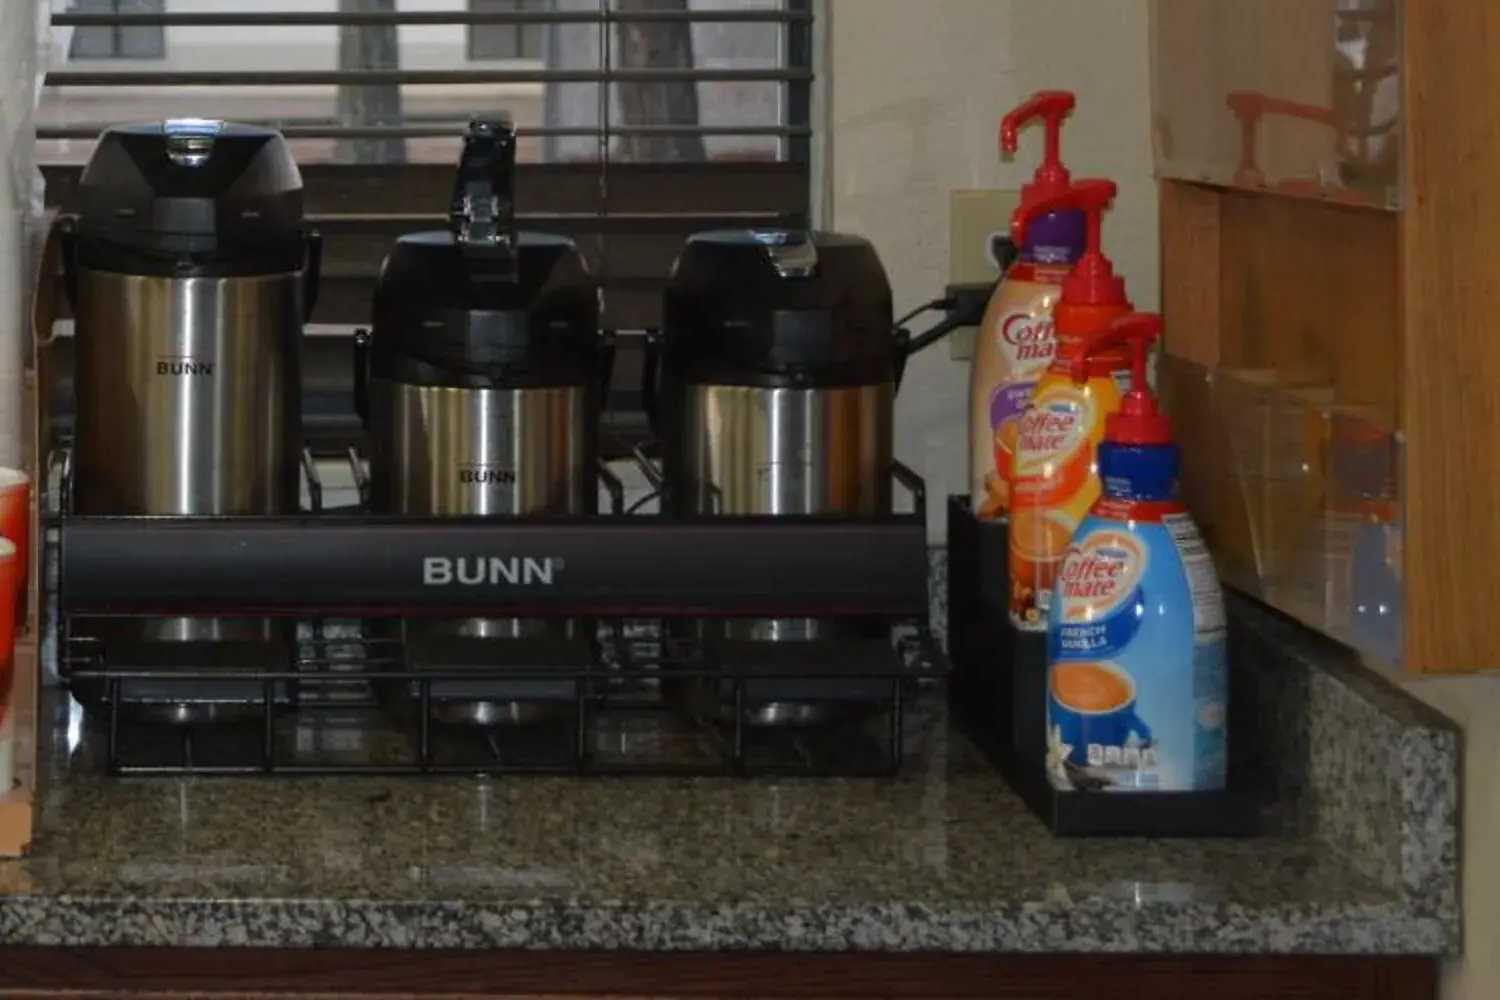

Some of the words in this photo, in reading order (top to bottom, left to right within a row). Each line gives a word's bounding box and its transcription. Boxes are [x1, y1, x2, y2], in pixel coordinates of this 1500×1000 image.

[1002, 313, 1055, 346] Coff
[156, 361, 213, 375] BUNN
[459, 469, 516, 484] BUNN
[422, 556, 554, 585] BUNN
